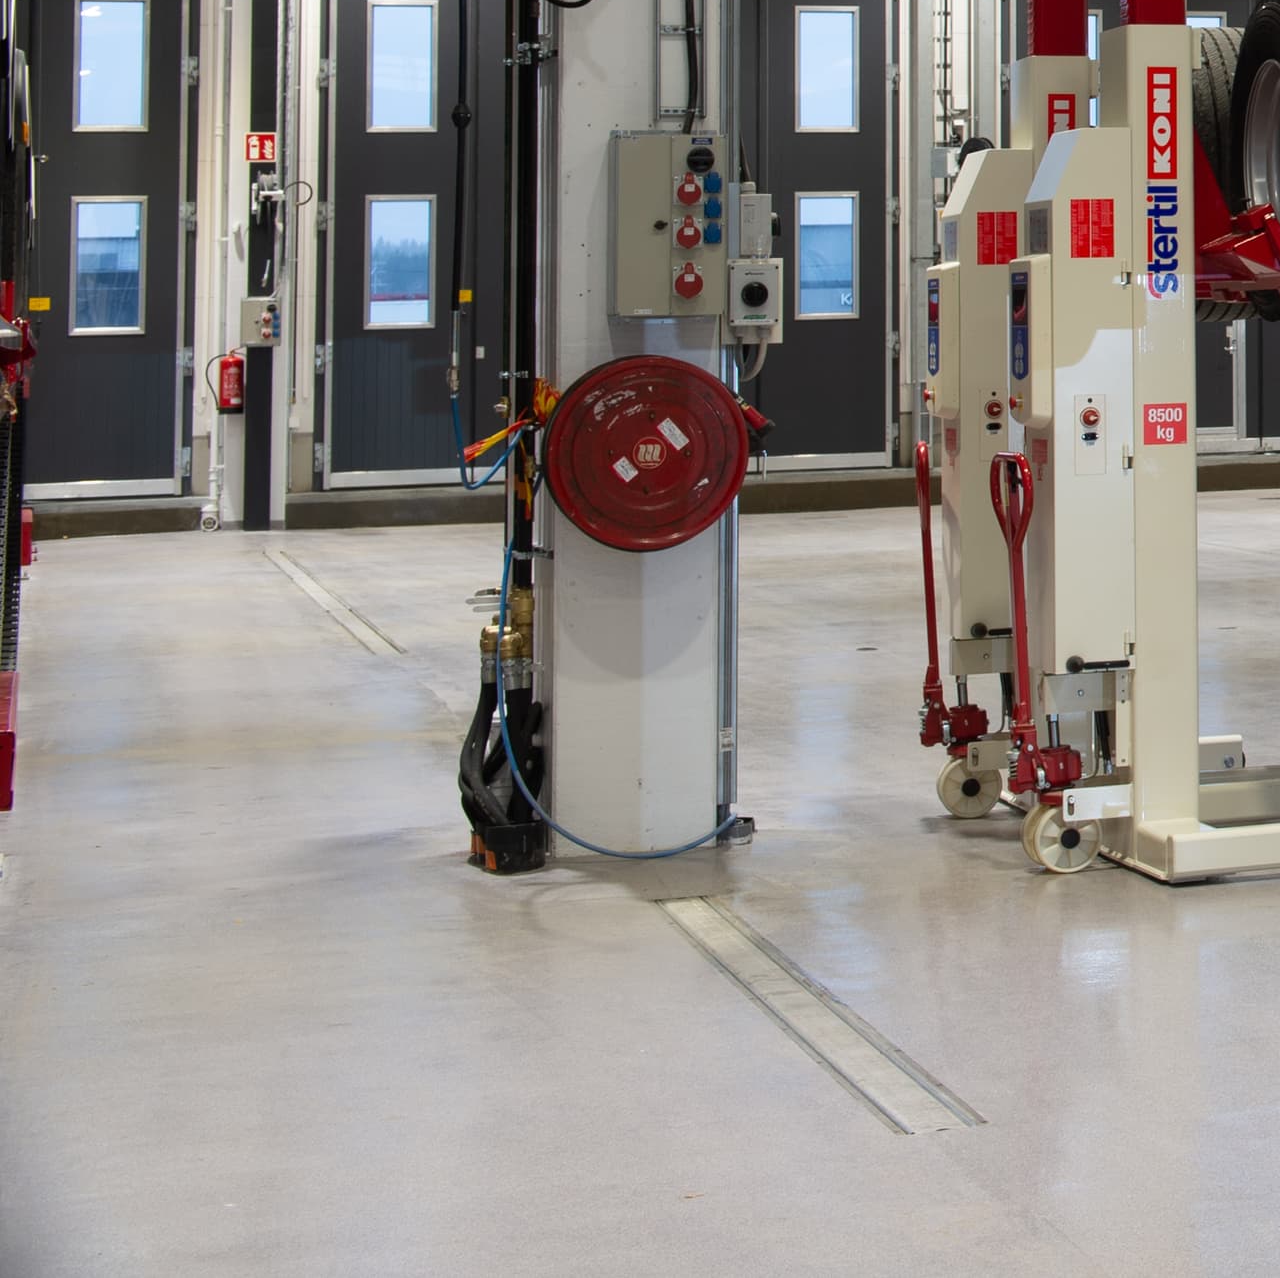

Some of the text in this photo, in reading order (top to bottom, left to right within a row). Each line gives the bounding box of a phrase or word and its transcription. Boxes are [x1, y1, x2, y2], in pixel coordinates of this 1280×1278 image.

[1053, 99, 1070, 132] NI
[1146, 73, 1179, 299] stertil KONI
[1147, 407, 1183, 423] 8500
[1156, 424, 1175, 442] kg
